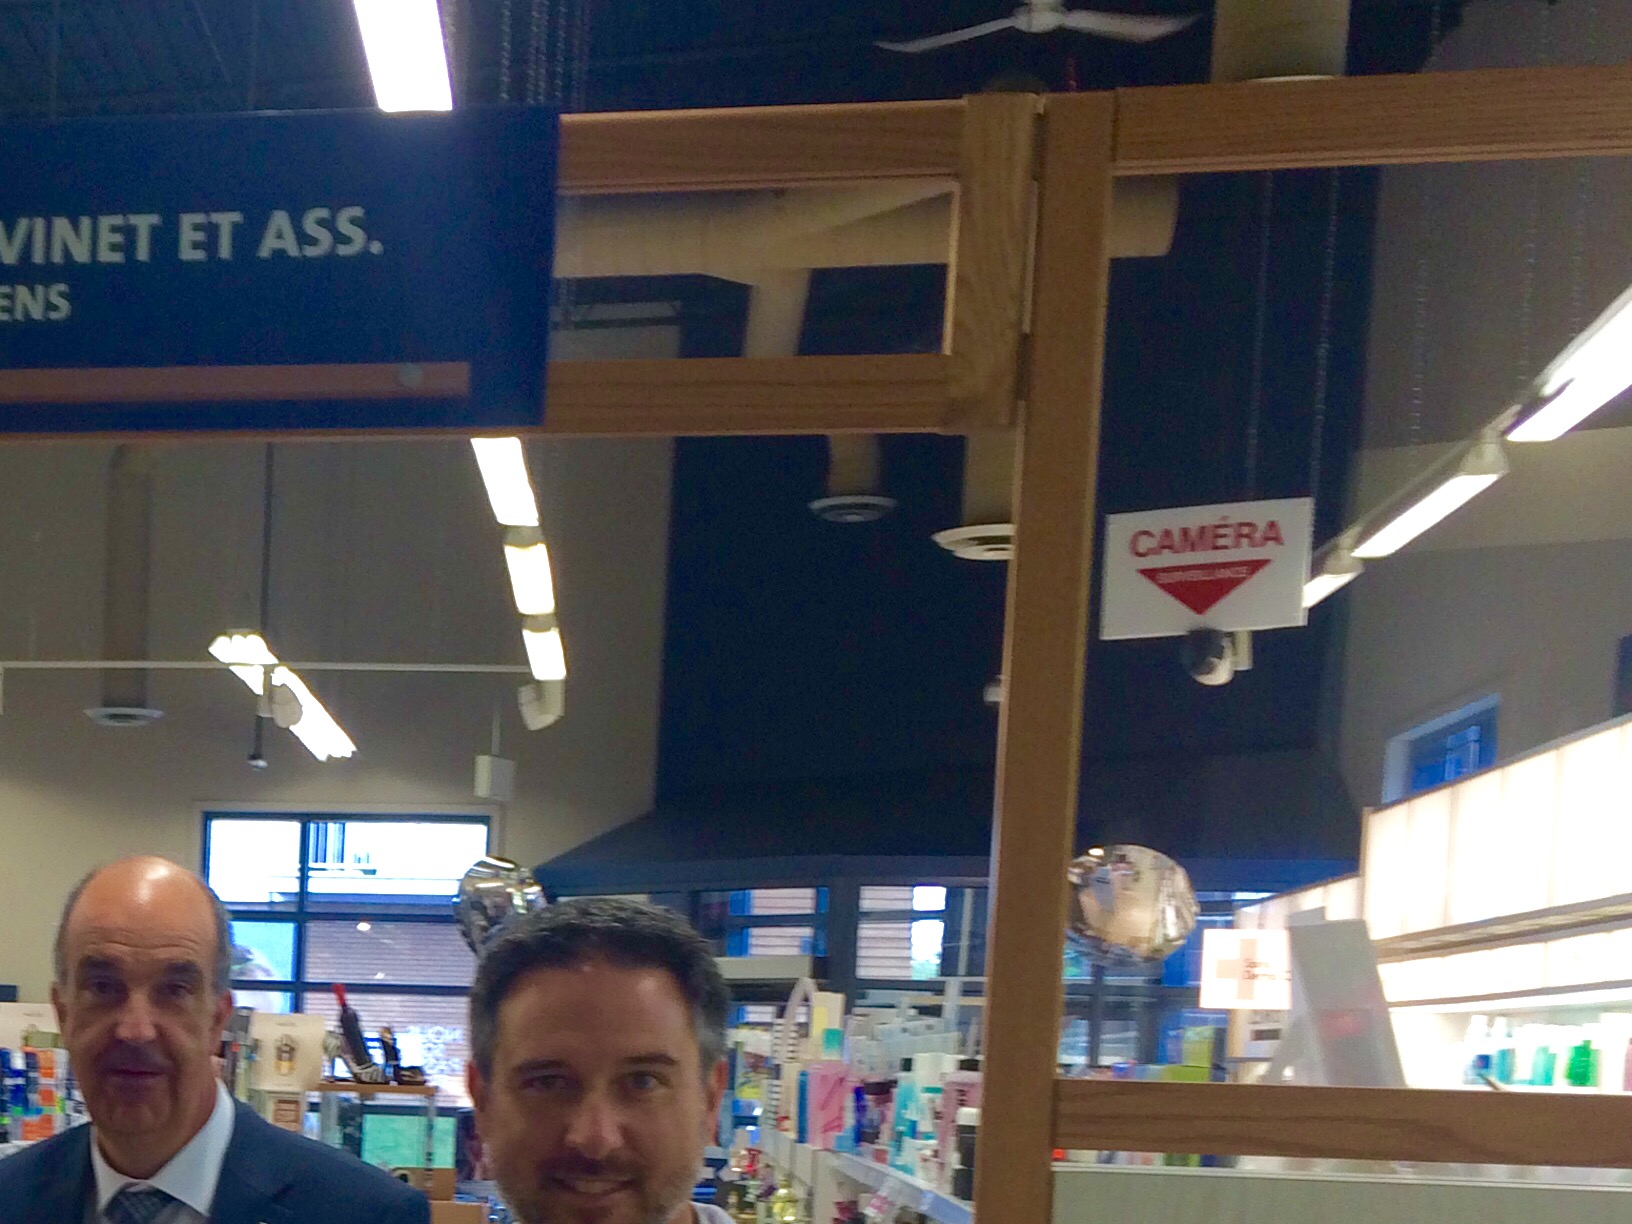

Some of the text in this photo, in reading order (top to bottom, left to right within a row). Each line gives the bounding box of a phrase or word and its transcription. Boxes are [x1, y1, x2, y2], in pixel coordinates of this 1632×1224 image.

[177, 211, 243, 261] ET
[256, 205, 383, 259] ASS.
[1129, 515, 1284, 558] CAMÉRA
